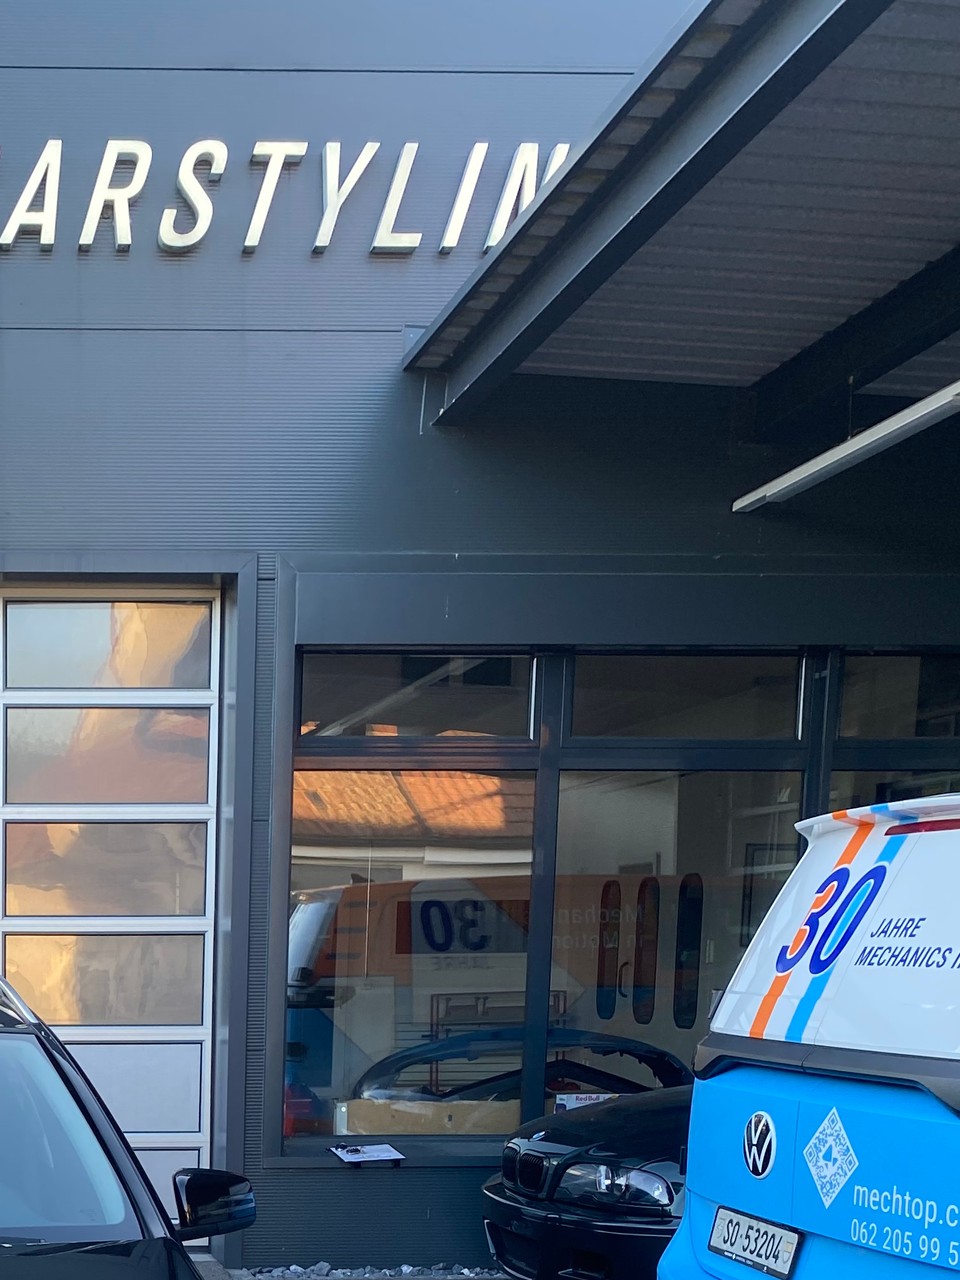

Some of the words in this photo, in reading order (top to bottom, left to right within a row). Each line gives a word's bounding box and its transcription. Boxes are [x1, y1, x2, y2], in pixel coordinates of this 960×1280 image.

[775, 864, 888, 976] 30
[870, 917, 927, 938] JAHRE
[854, 946, 953, 969] MECHANICS
[850, 1218, 877, 1247] 062
[882, 1226, 913, 1256] 205
[918, 1234, 941, 1261] 99
